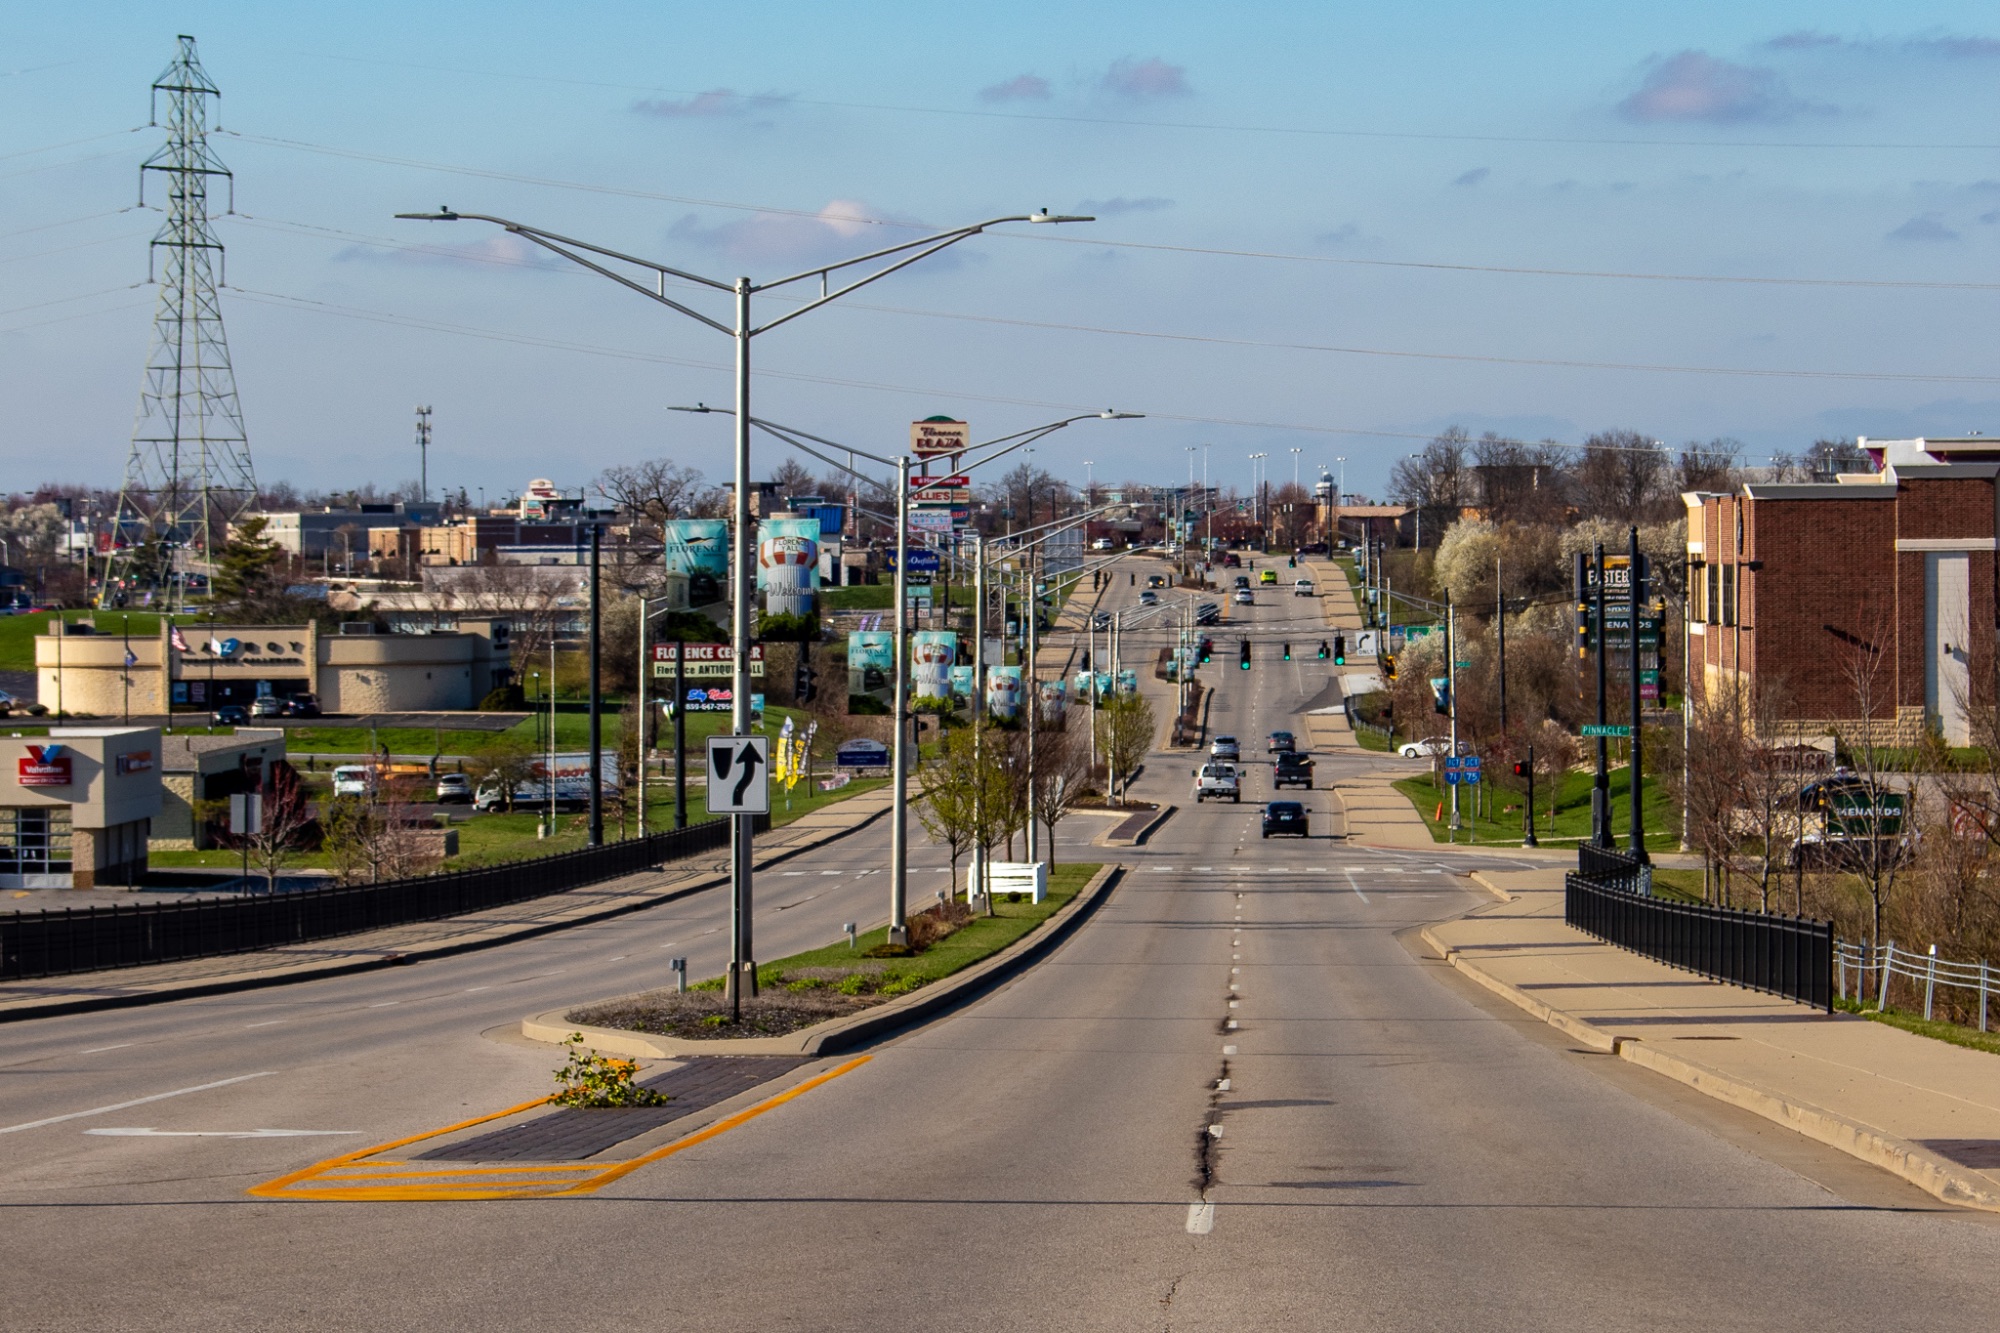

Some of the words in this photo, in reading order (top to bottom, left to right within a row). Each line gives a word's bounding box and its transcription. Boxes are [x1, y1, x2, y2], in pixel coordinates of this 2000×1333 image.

[917, 438, 965, 448] PLAZA
[669, 545, 722, 555] FLORENCE
[763, 582, 815, 597] Welcome
[656, 646, 714, 659] FLOENCE
[717, 646, 761, 659] CER
[1582, 726, 1622, 735] PINNACLE
[1450, 773, 1457, 781] 71
[1467, 773, 1477, 781] 75
